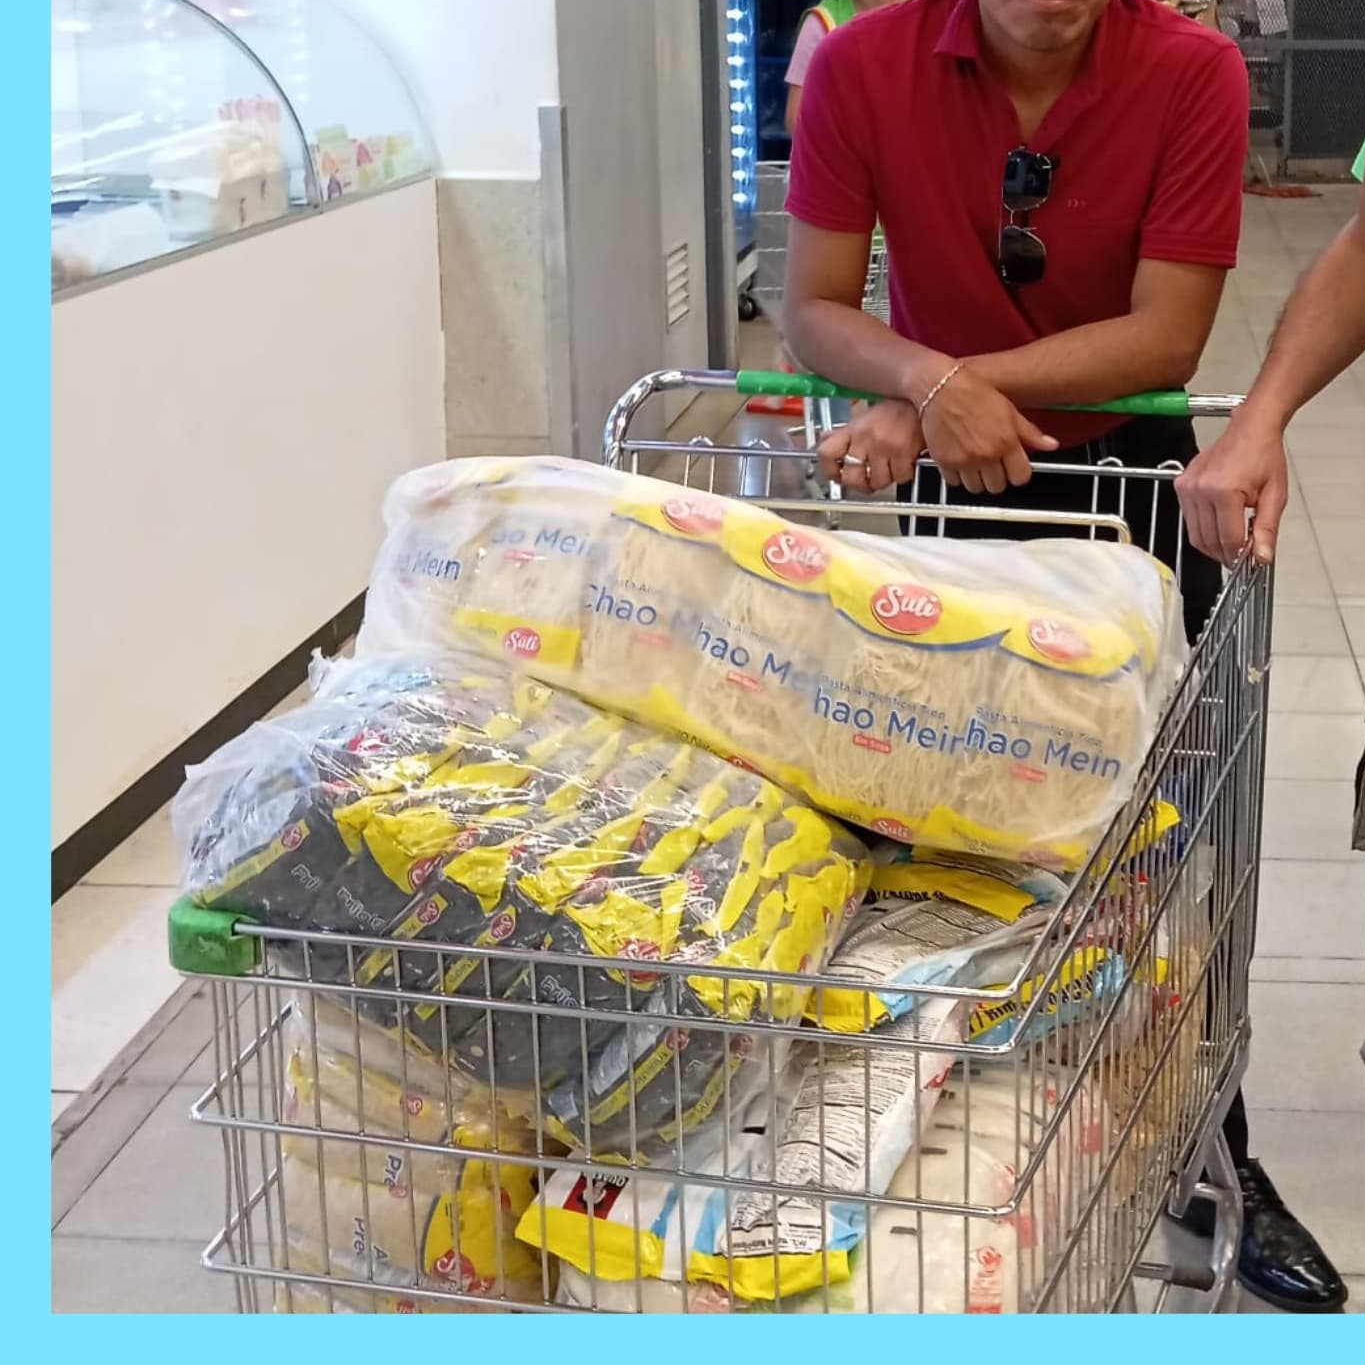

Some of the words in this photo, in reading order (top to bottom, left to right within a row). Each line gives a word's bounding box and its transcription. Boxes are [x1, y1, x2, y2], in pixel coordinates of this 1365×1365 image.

[874, 587, 937, 618] Suli
[504, 627, 541, 655] Suli
[813, 684, 874, 731] hao
[966, 718, 1032, 760] hao
[1043, 738, 1122, 781] Mein
